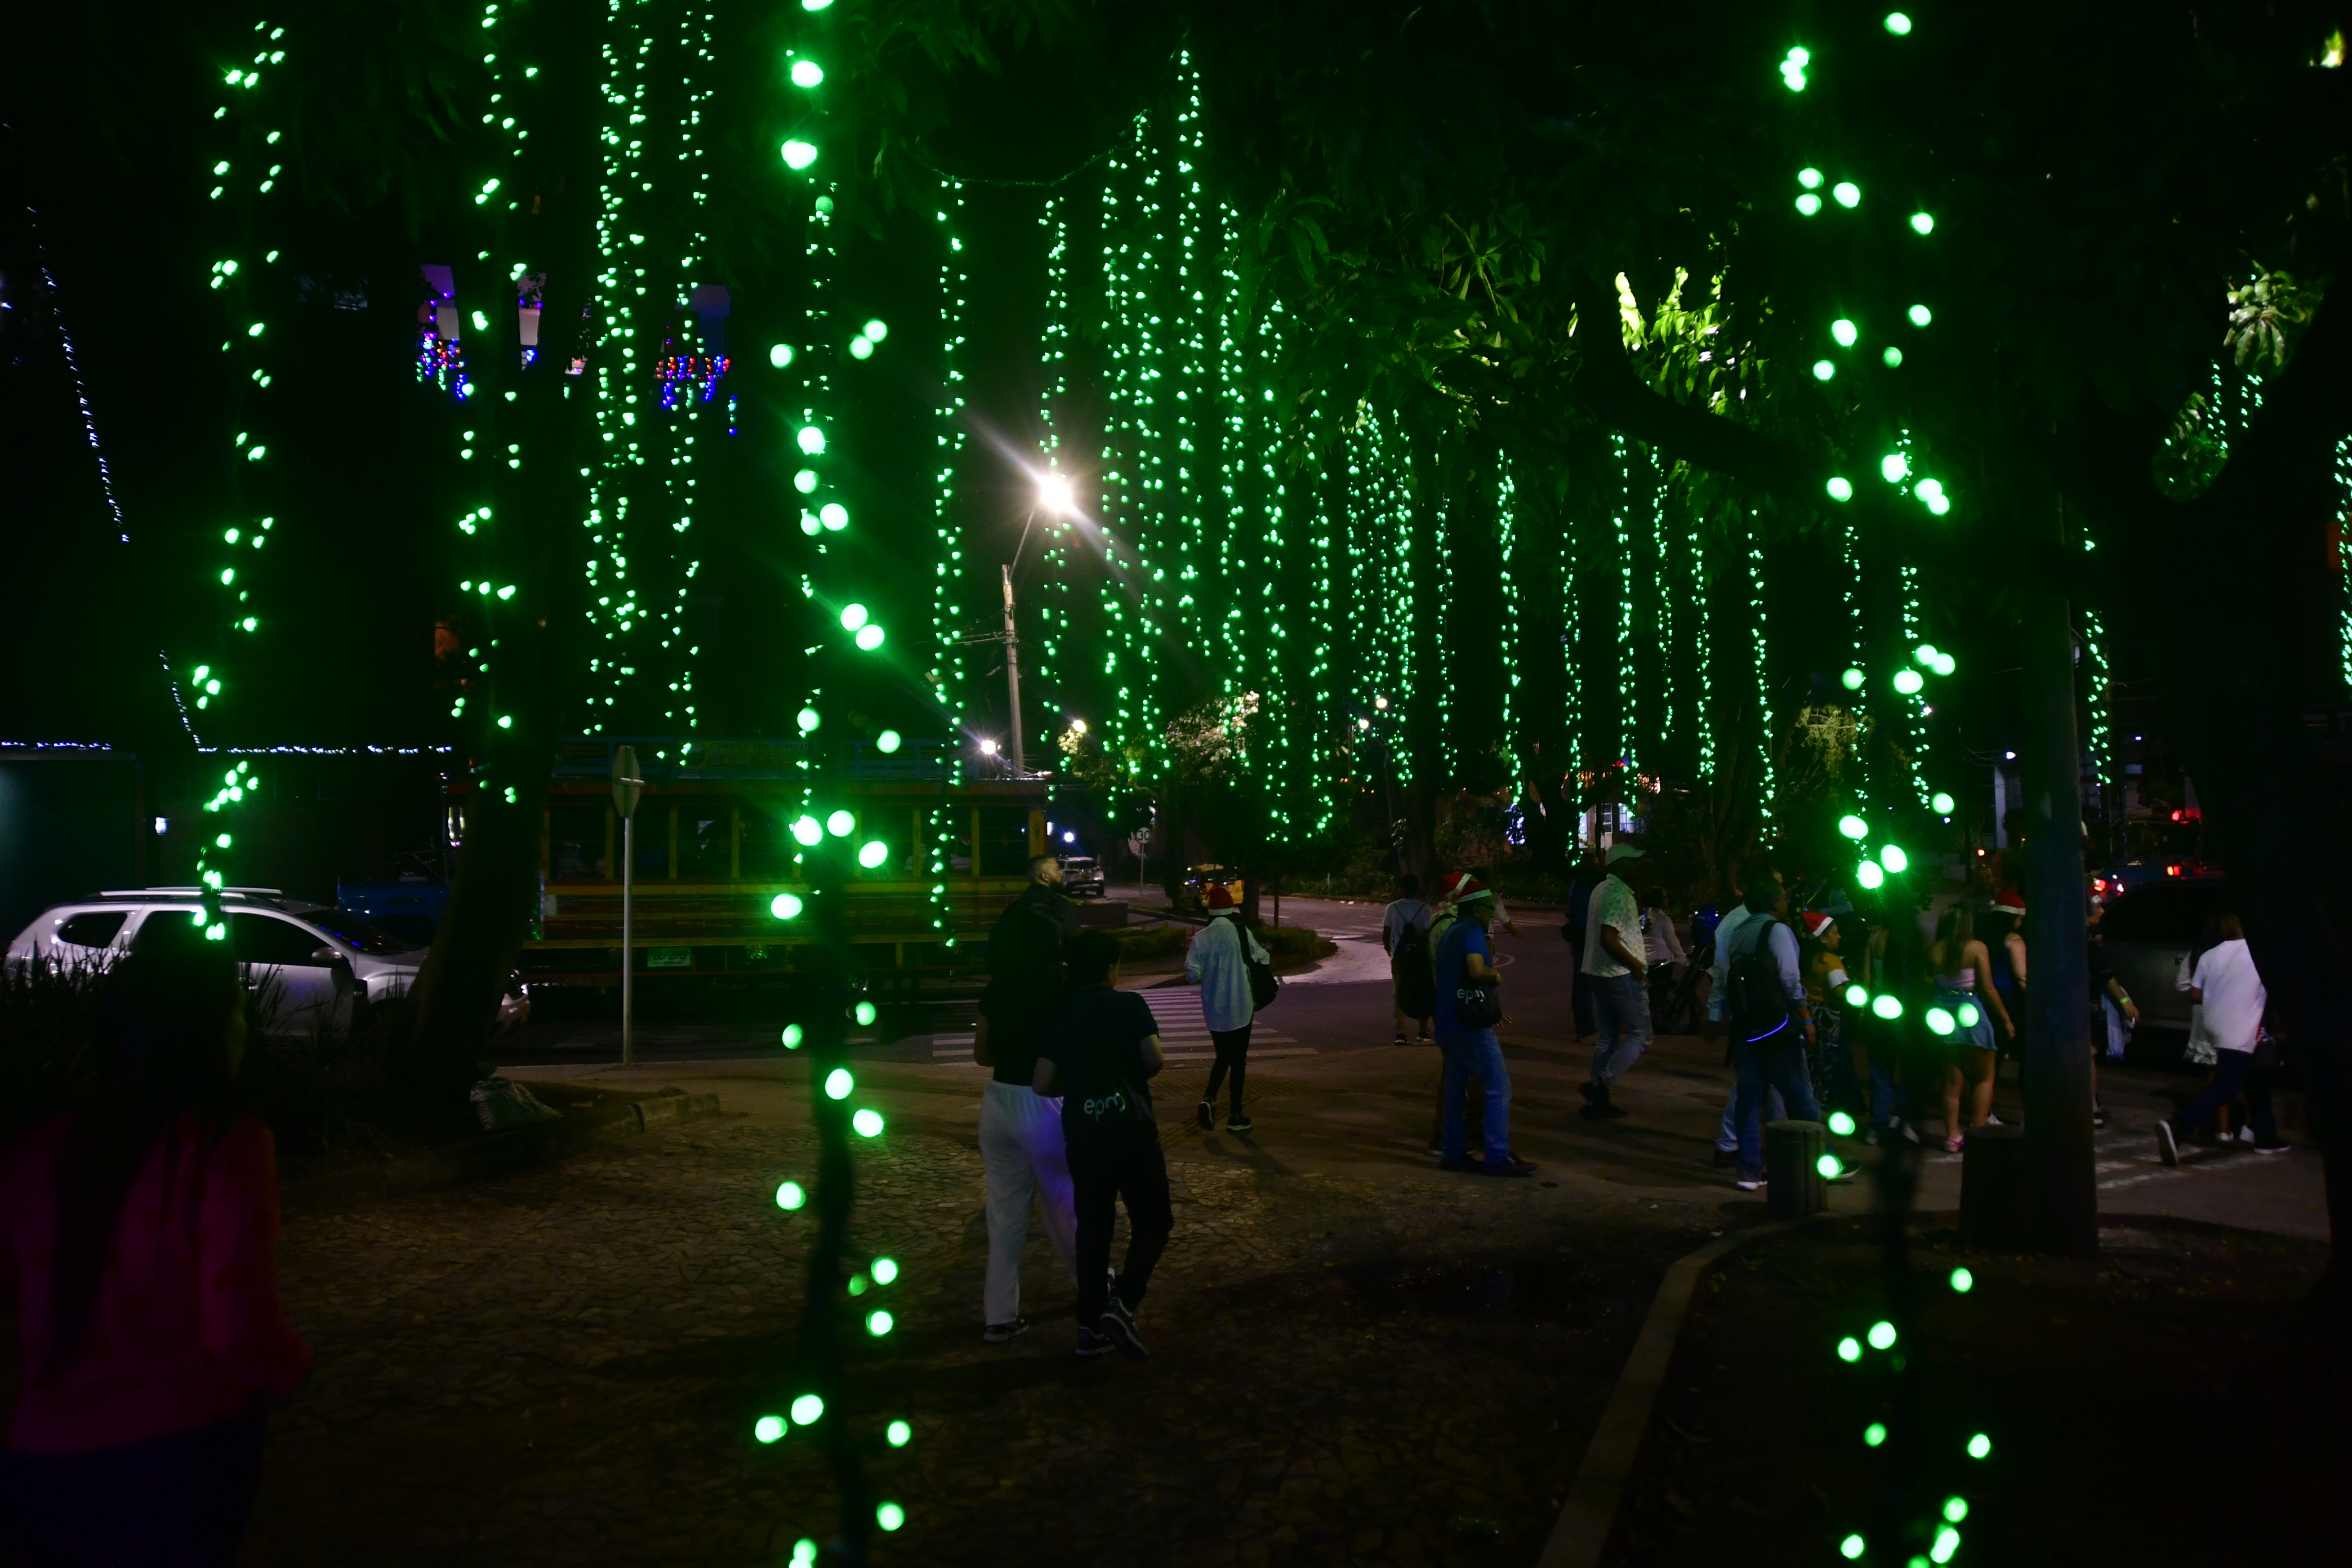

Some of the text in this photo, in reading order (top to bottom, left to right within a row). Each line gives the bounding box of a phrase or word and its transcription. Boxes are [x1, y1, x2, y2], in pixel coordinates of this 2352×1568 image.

[1138, 830, 1150, 841] 30
[1456, 988, 1485, 1004] epm
[1084, 1092, 1126, 1122] epm
